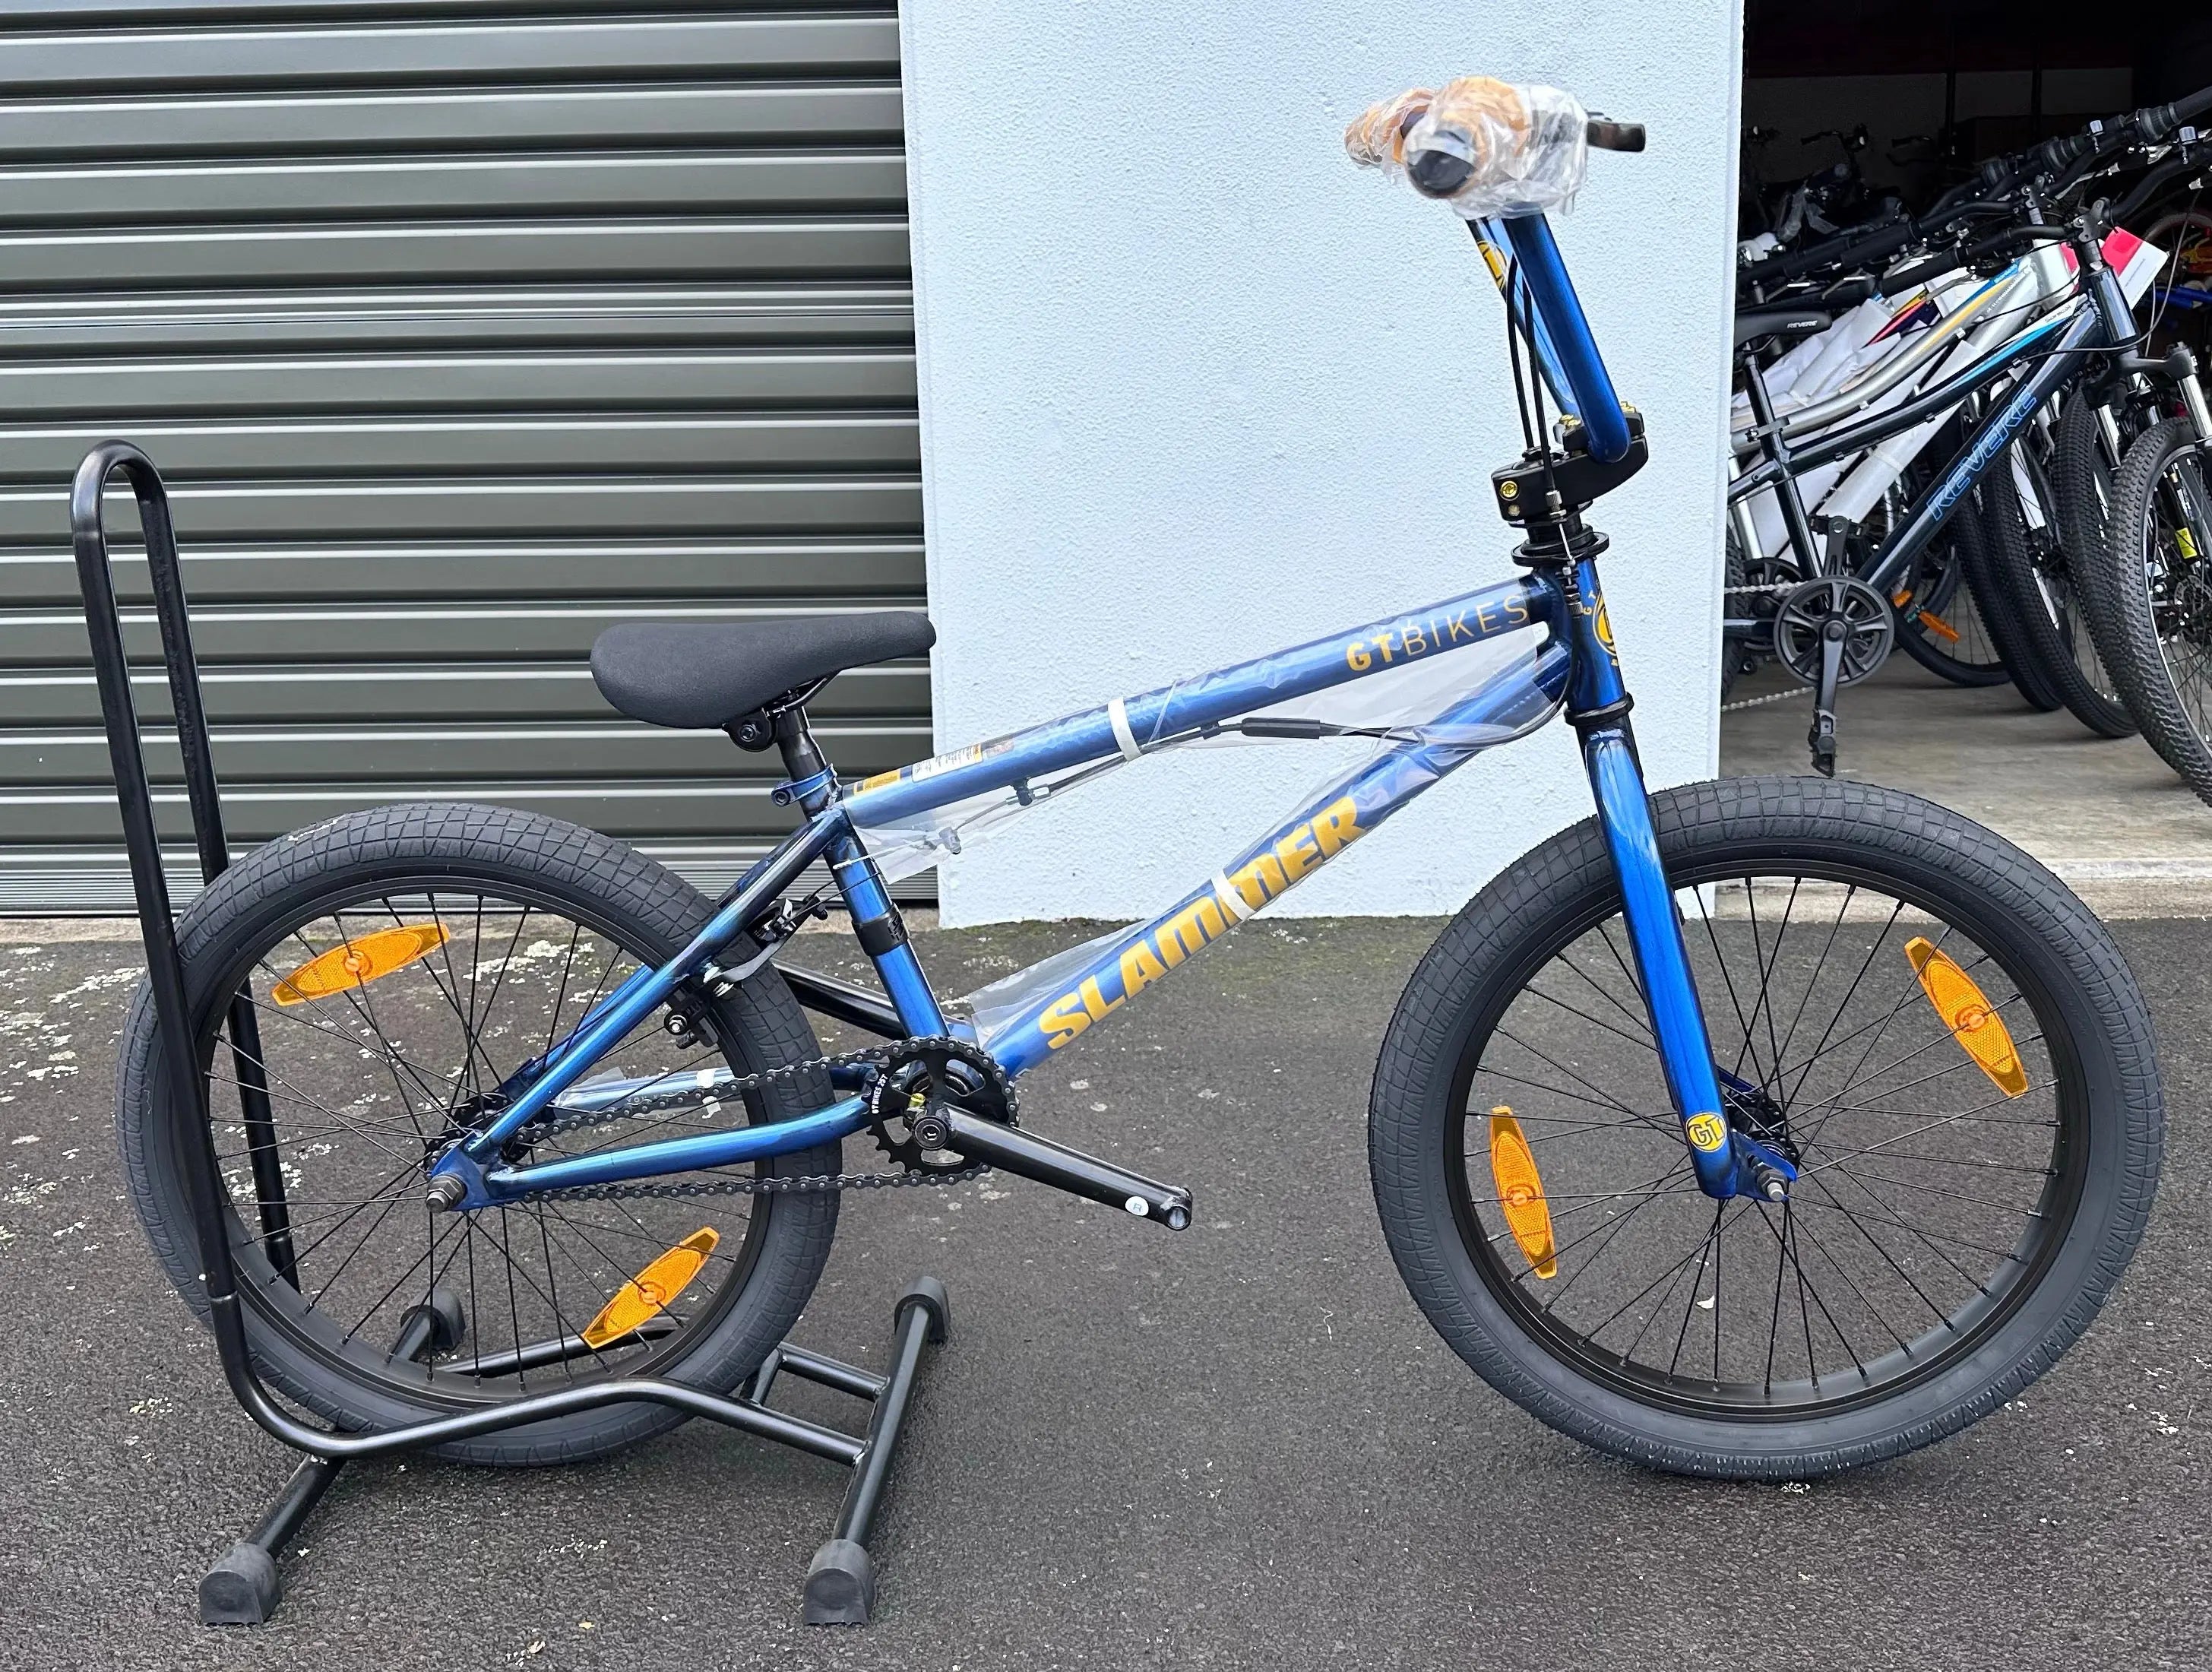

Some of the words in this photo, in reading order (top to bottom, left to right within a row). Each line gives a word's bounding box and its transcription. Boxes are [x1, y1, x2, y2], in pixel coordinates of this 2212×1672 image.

[1926, 383, 2037, 521] REVERE
[1039, 796, 1368, 1050] SLAMMER
[1687, 1115, 1726, 1148] GT
